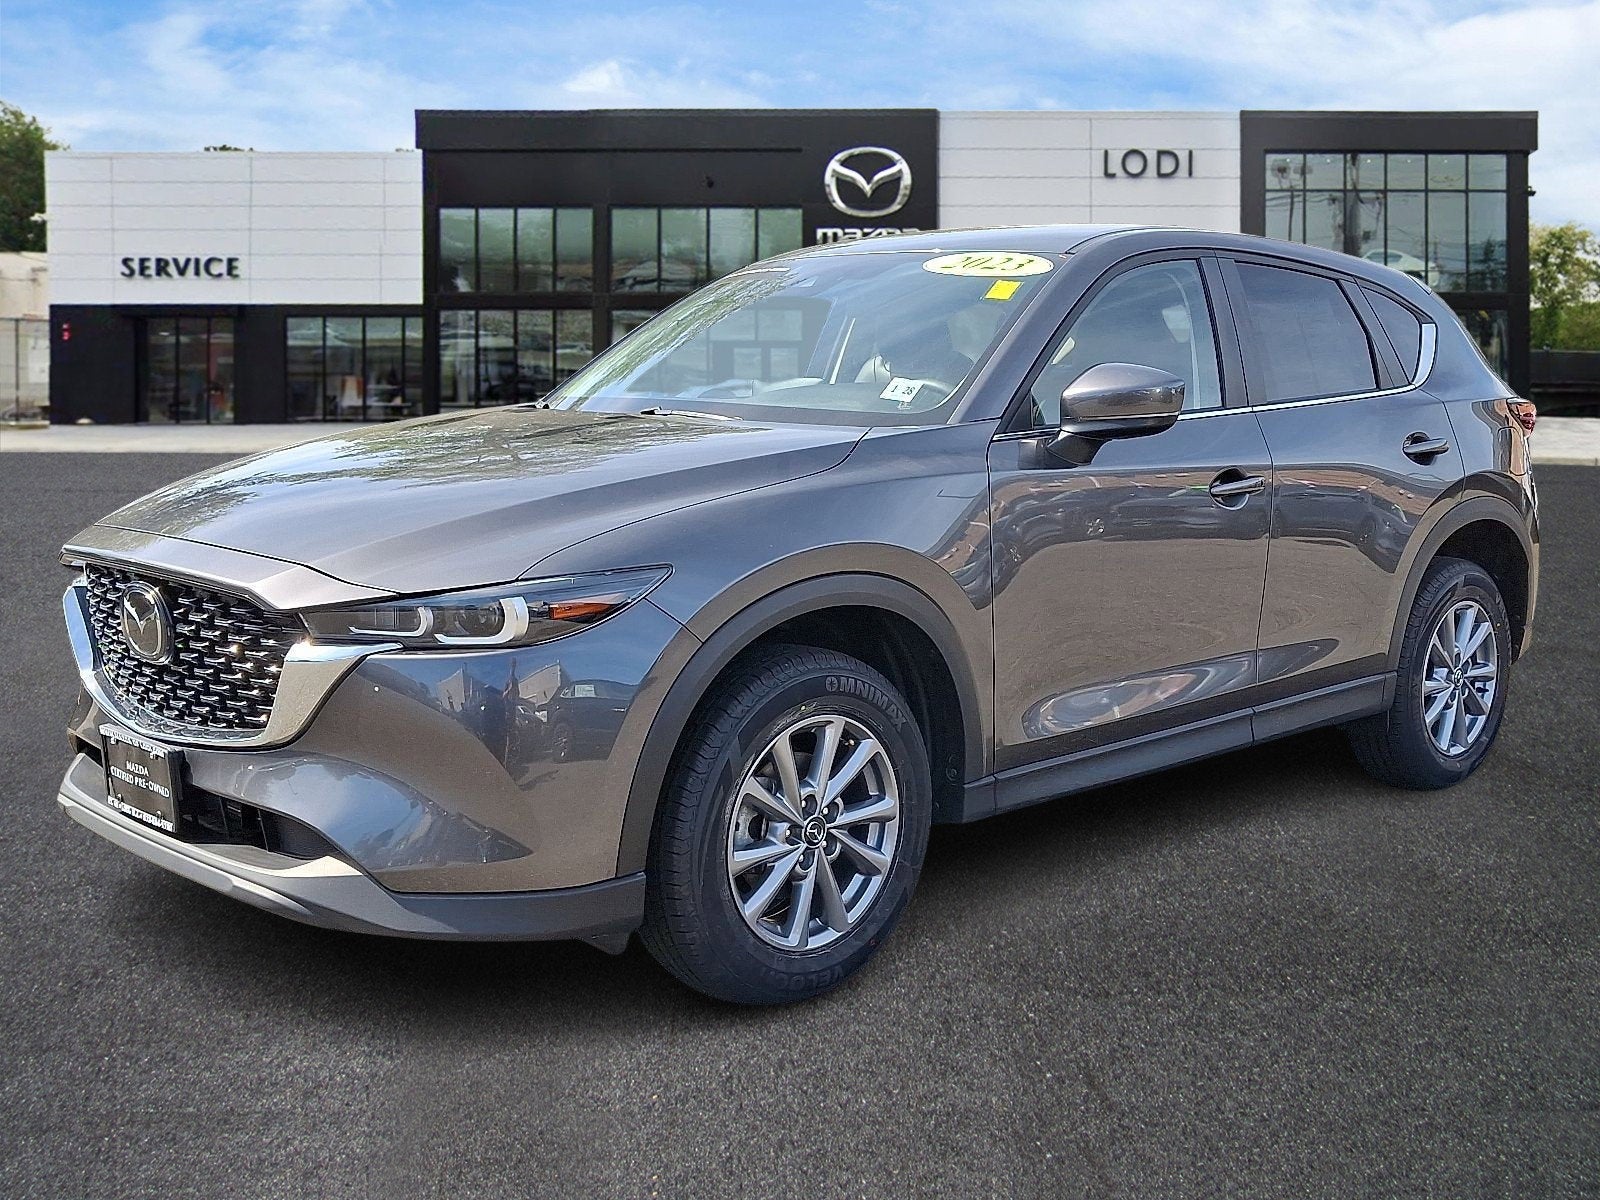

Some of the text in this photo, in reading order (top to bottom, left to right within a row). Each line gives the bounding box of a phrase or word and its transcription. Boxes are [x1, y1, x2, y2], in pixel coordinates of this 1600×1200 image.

[1103, 148, 1193, 178] LODI
[816, 227, 920, 243] maz
[120, 256, 240, 278] SERVICE
[940, 256, 1034, 271] 2023
[825, 676, 907, 733] OMNIMAX
[125, 760, 149, 777] MAZDA
